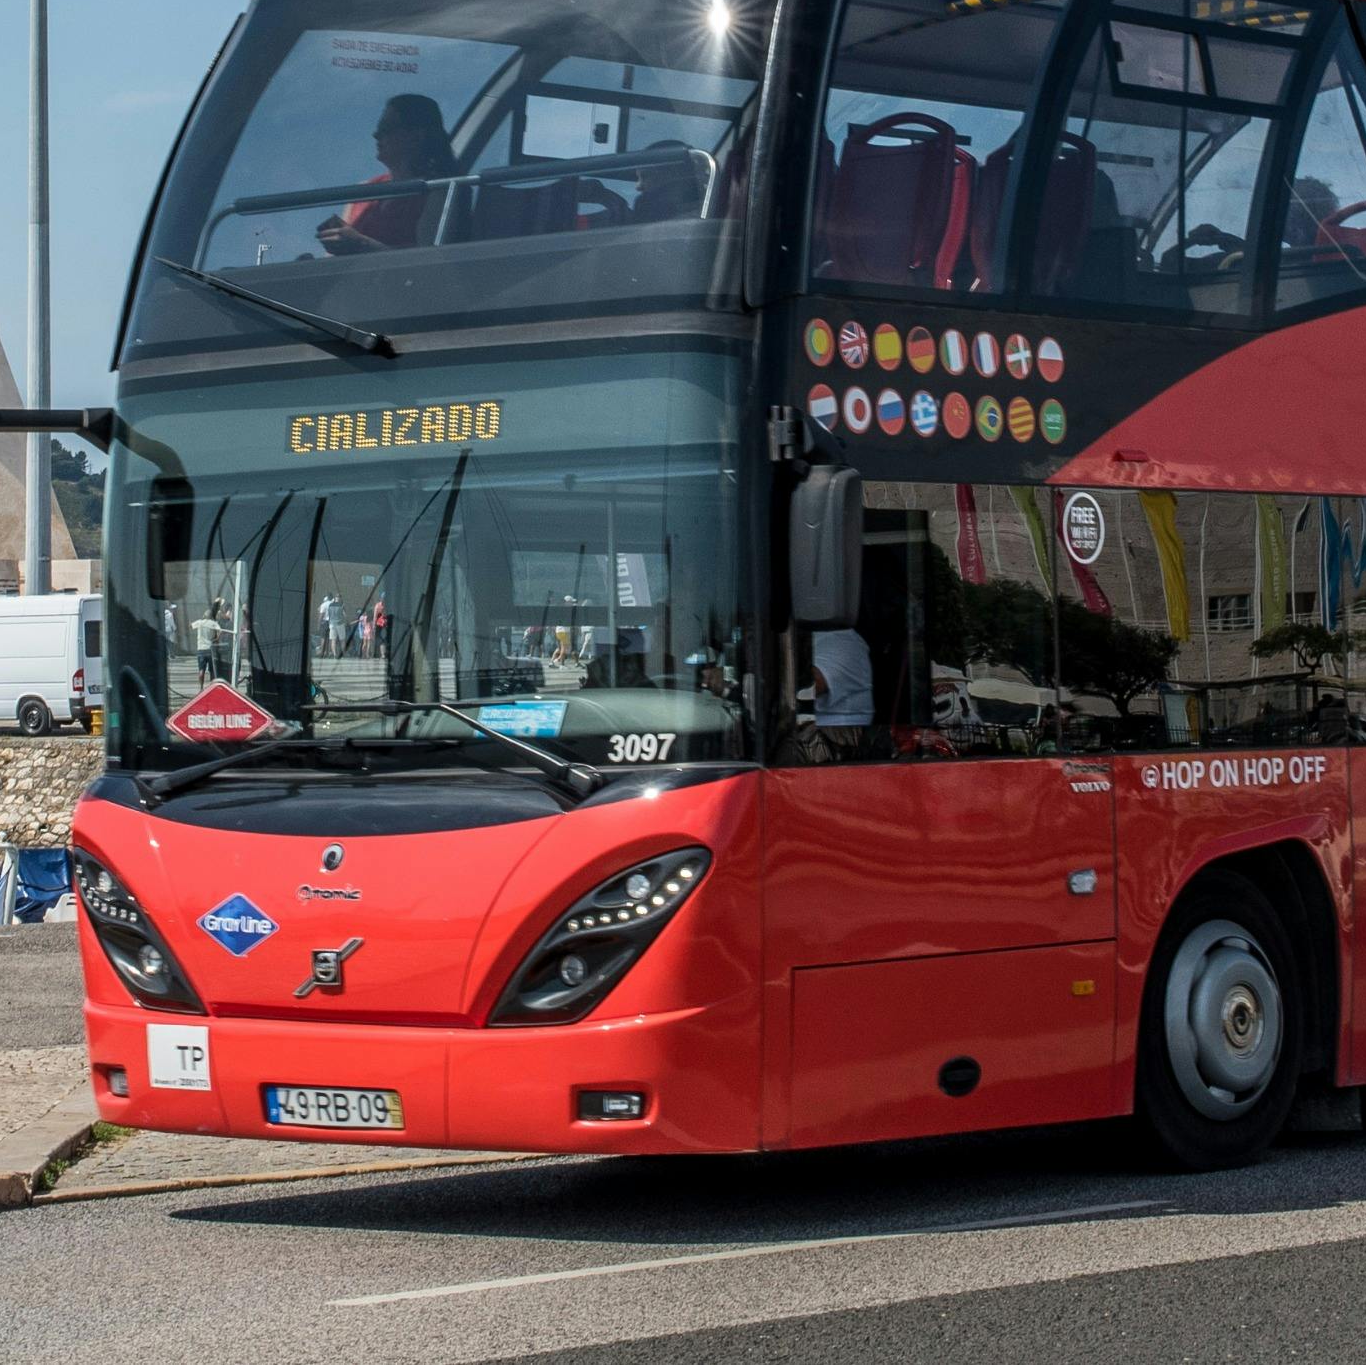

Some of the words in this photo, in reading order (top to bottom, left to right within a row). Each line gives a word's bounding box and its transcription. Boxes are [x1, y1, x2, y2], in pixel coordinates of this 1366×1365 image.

[291, 402, 501, 453] CIALIZADO
[607, 733, 676, 762] 3097
[1070, 781, 1111, 793] VOLVO
[1162, 761, 1205, 789] HOP
[1209, 759, 1239, 786] ON
[1243, 757, 1285, 785] HOP
[1288, 756, 1326, 783] OFF
[176, 1045, 205, 1071] TP
